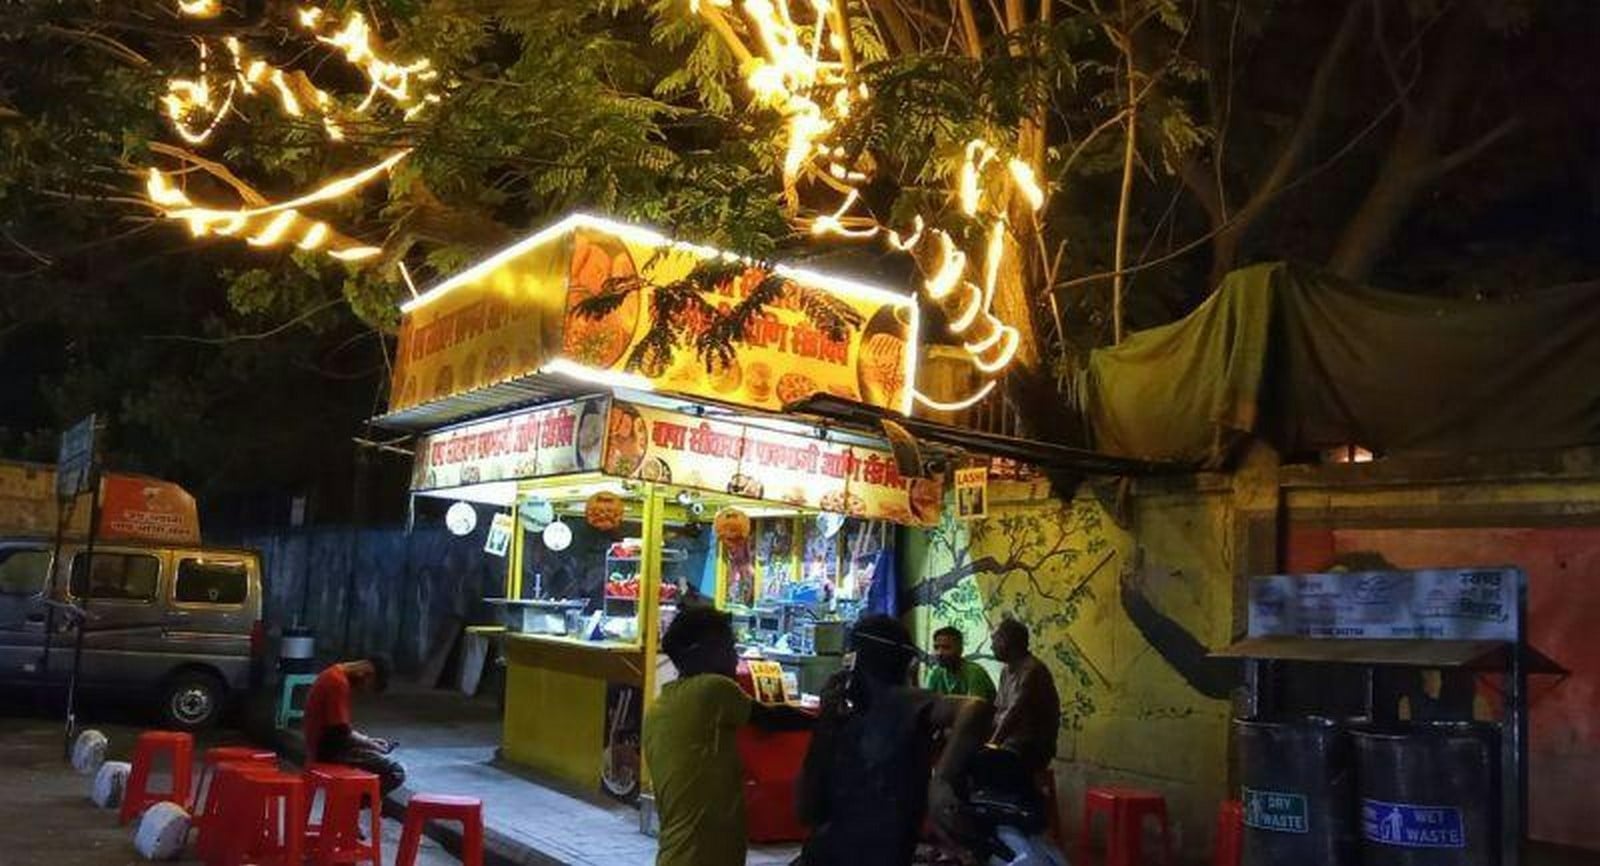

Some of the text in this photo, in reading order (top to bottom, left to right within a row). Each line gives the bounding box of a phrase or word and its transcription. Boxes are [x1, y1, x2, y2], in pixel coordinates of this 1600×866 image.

[1267, 796, 1292, 810] DRY
[1262, 813, 1304, 830] WASTE
[1414, 810, 1445, 824] WET
[1407, 829, 1459, 844] WASTE
